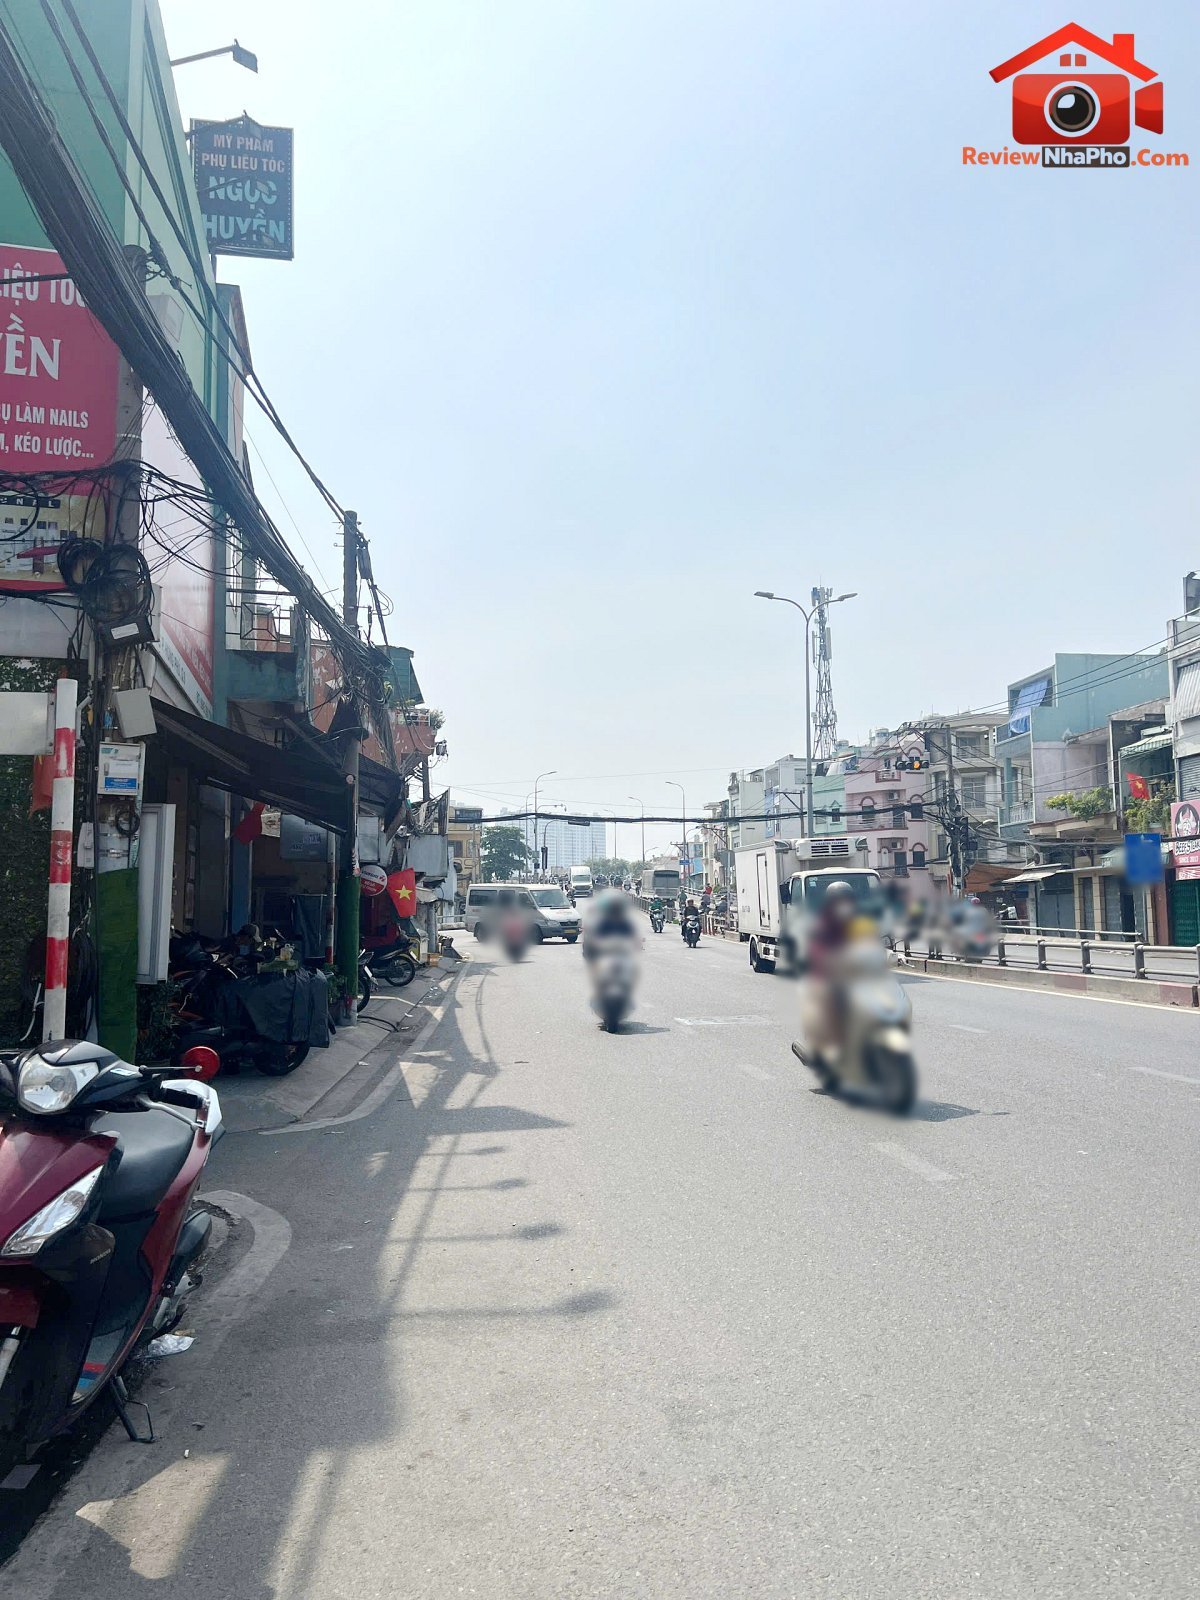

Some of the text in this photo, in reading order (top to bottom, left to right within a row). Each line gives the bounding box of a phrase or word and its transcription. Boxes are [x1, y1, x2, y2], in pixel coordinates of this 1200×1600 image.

[201, 153, 227, 170] PHỤ
[261, 156, 285, 173] TÓC
[209, 176, 278, 209] NGỌC
[0, 262, 40, 306] IỆU
[0, 312, 62, 381] ỀN
[0, 401, 89, 429] Ụ LÀM NAILS
[14, 431, 41, 453] KÉO
